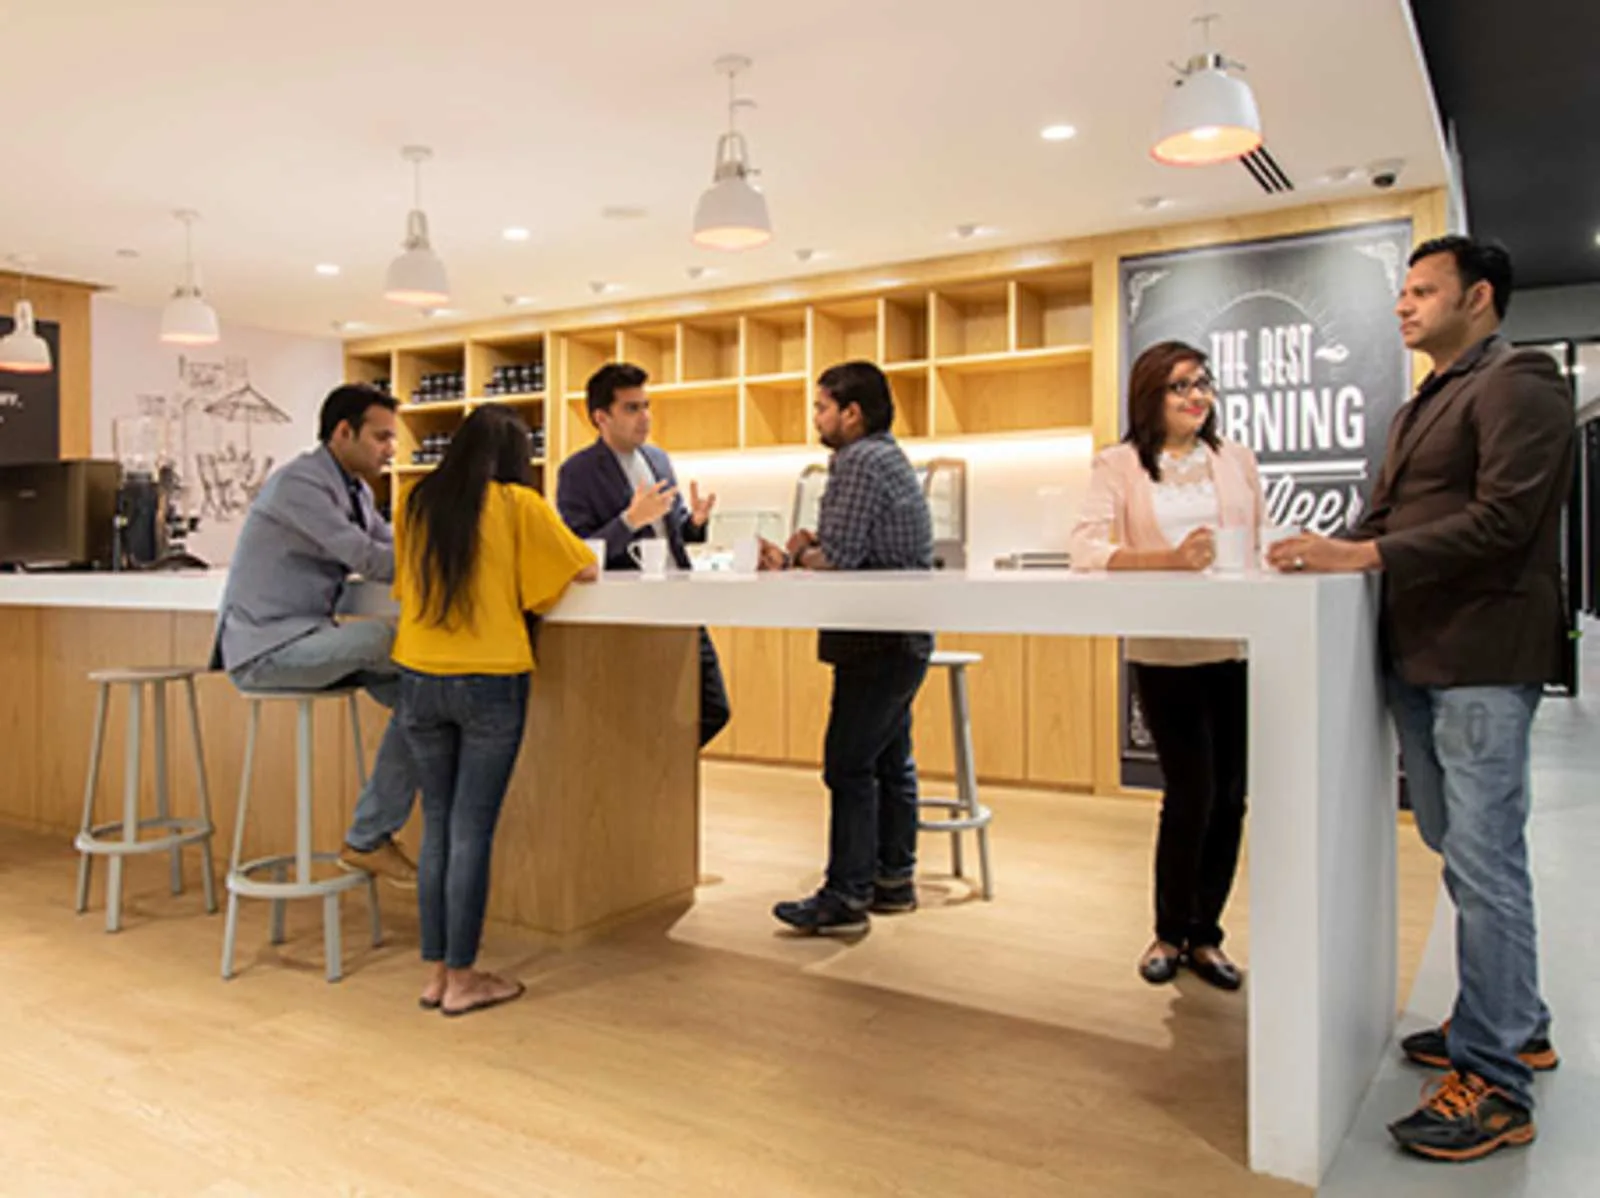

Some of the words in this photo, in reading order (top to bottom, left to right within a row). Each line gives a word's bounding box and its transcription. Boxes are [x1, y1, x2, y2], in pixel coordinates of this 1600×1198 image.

[1210, 329, 1248, 390] THE
[1259, 323, 1314, 387] BEST
[1214, 385, 1365, 452] RNING
